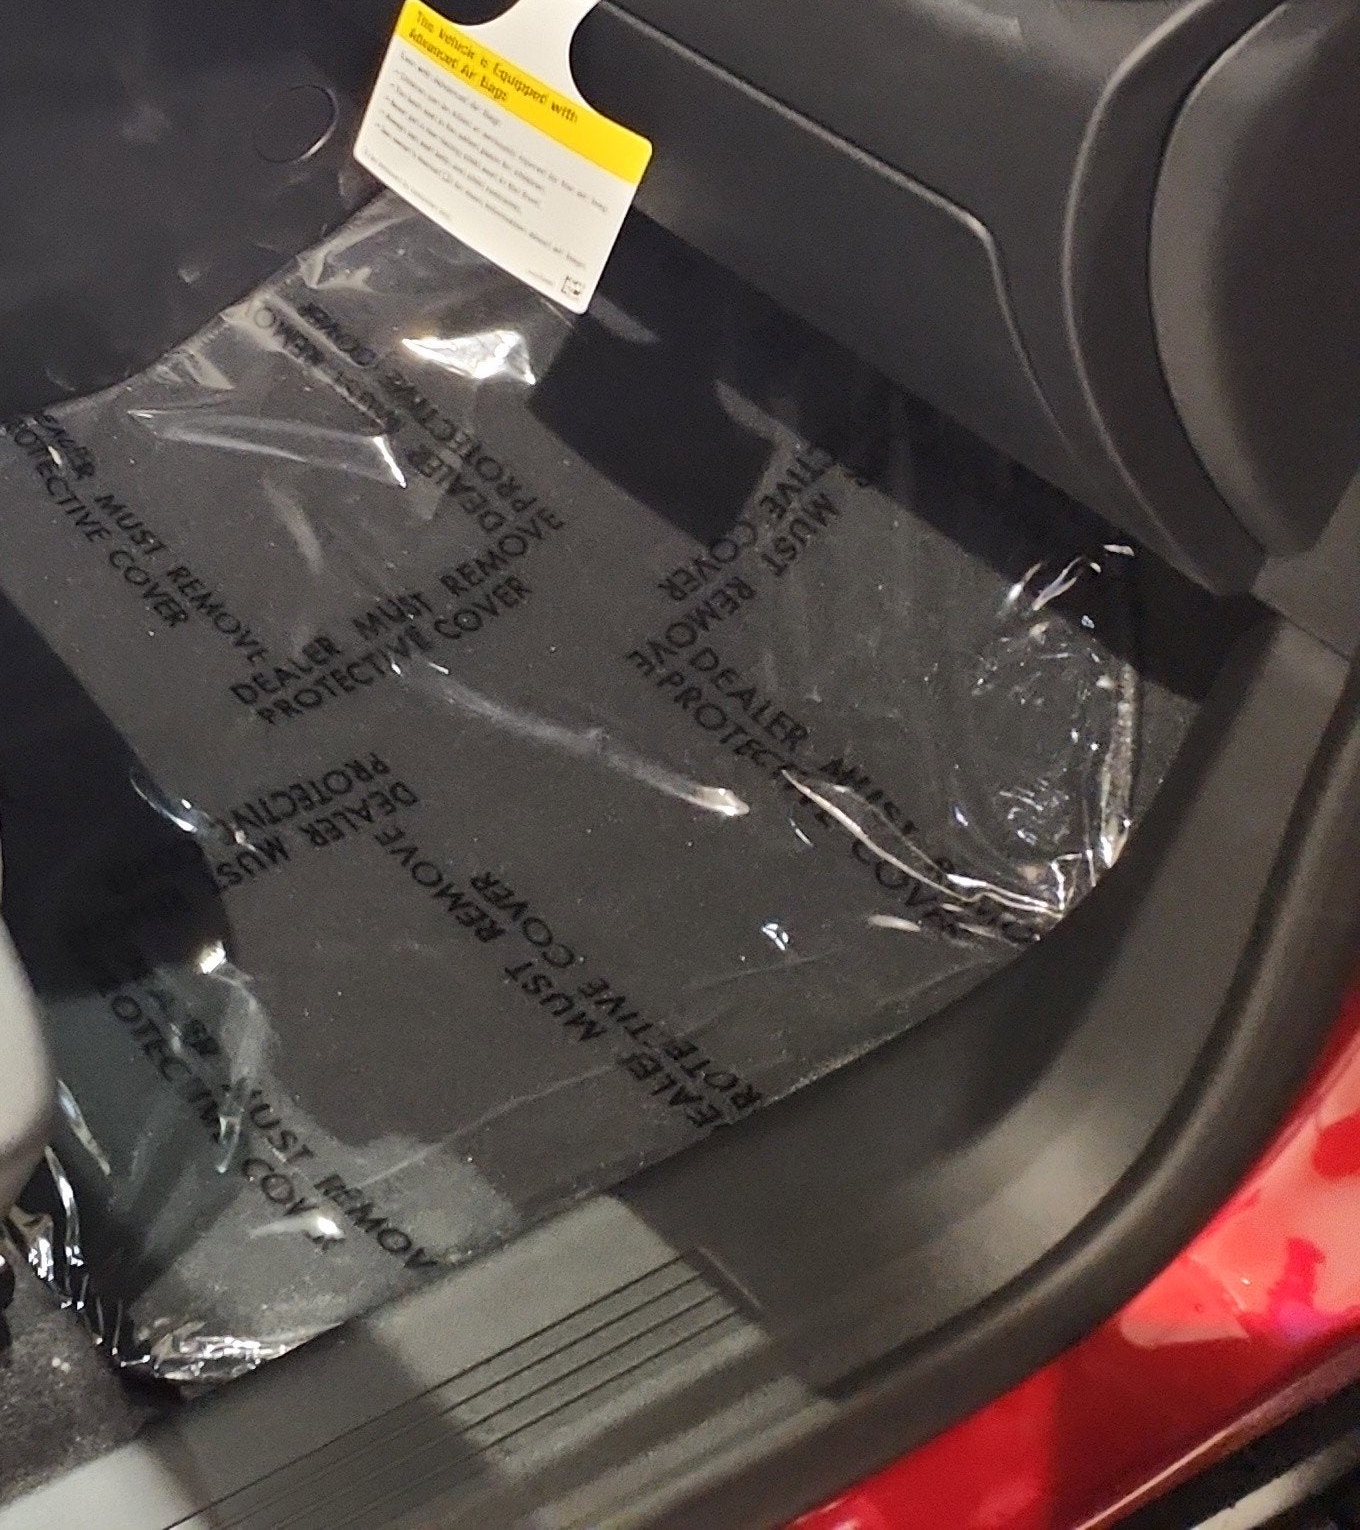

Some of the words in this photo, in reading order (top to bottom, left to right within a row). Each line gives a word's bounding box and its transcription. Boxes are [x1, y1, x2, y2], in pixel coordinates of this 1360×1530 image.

[493, 62, 548, 104] Equipped
[551, 102, 578, 123] with
[94, 493, 167, 556] MUST
[167, 566, 269, 666] REMOVE
[657, 520, 758, 601] COVER
[760, 492, 841, 577] MUST
[109, 550, 189, 628] COVER
[231, 636, 342, 706] DEALER
[351, 591, 435, 641] MUST
[440, 506, 566, 597] REMOVE
[627, 576, 756, 677] REMOVE
[254, 625, 434, 726] PROTECTIVE
[434, 574, 533, 641] COVER
[689, 647, 809, 752] DEALER
[298, 781, 419, 847] DEALER
[375, 825, 506, 943] REMOVE
[470, 872, 575, 968] COVER
[503, 961, 608, 1042] MUST
